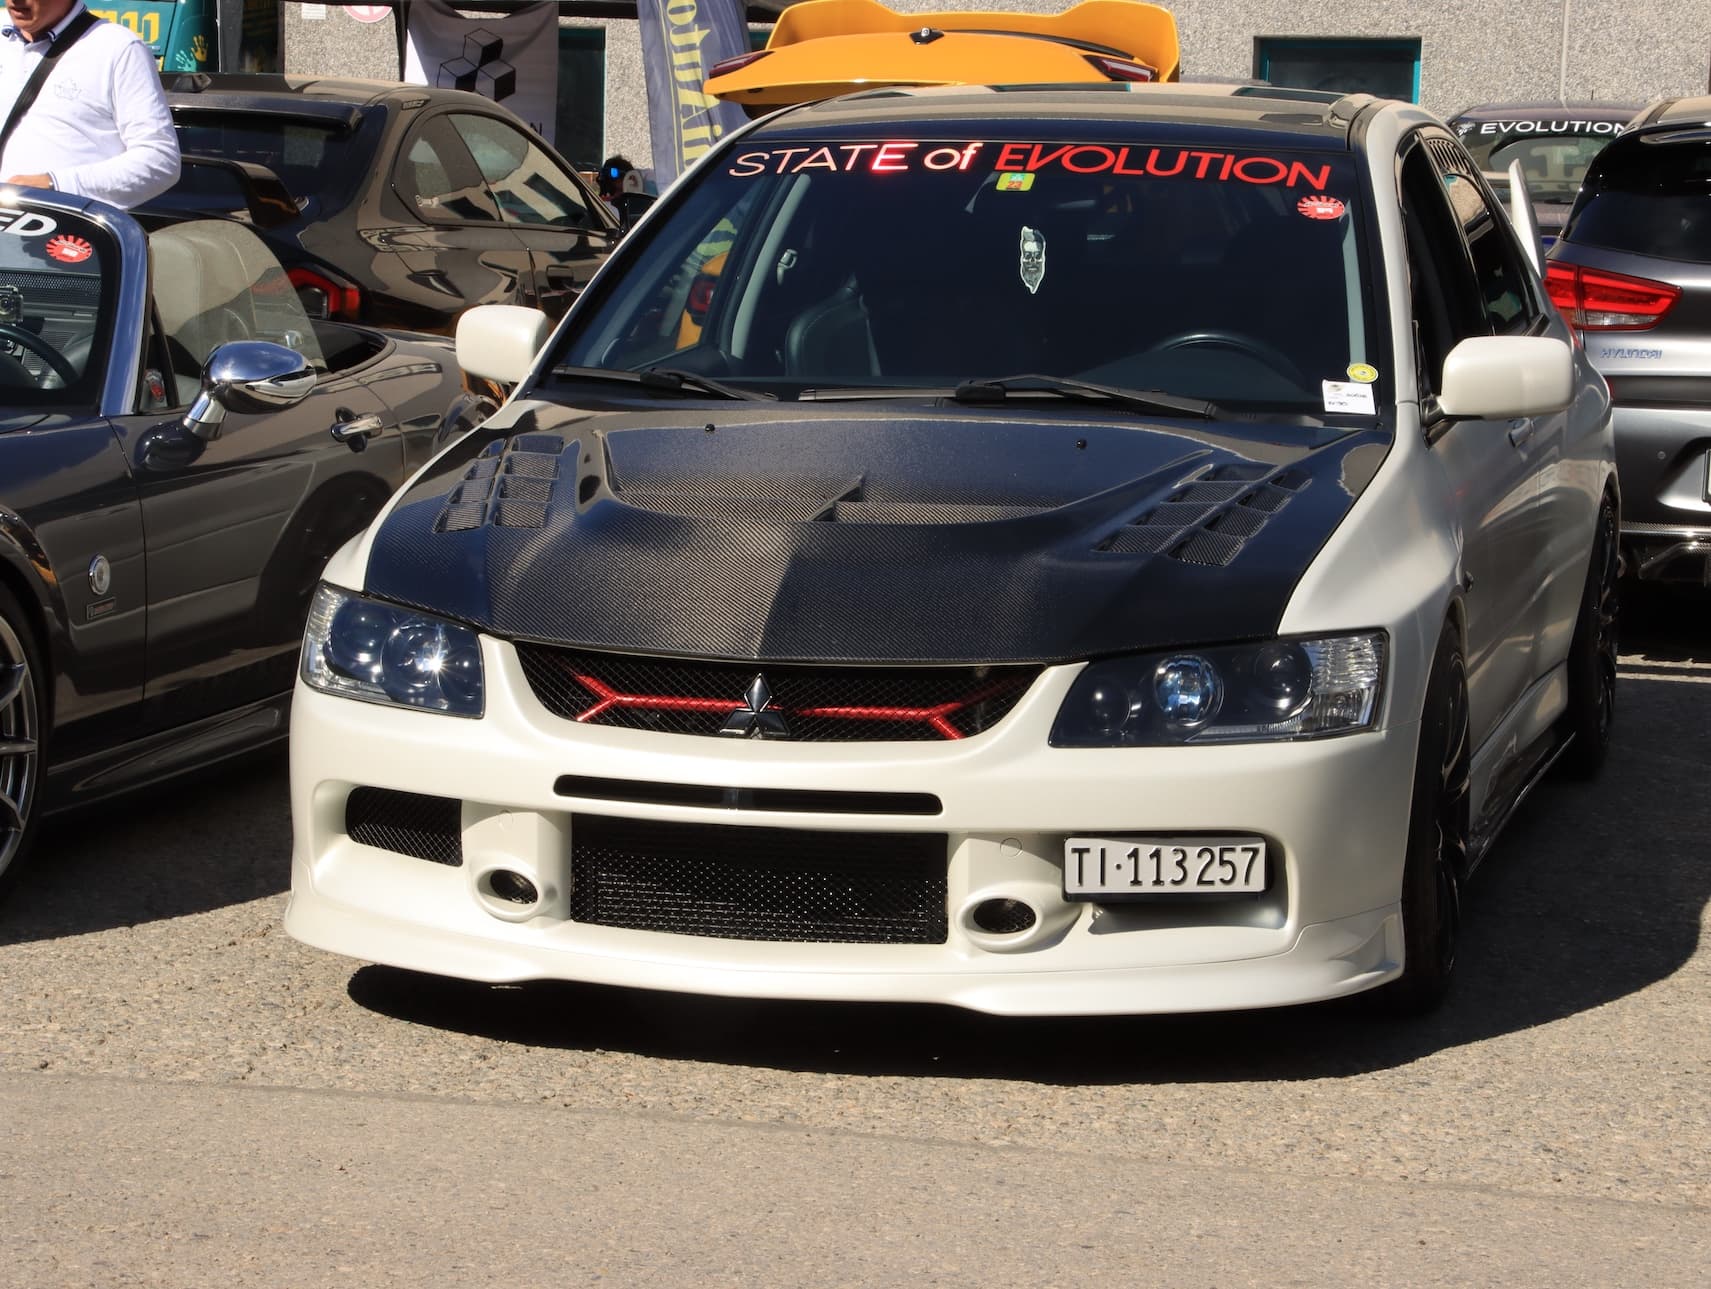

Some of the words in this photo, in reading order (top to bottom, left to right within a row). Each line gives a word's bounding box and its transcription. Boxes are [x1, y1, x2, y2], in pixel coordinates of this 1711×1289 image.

[729, 143, 919, 177] STATE
[923, 142, 984, 170] of
[995, 143, 1332, 190] EVOLUTION
